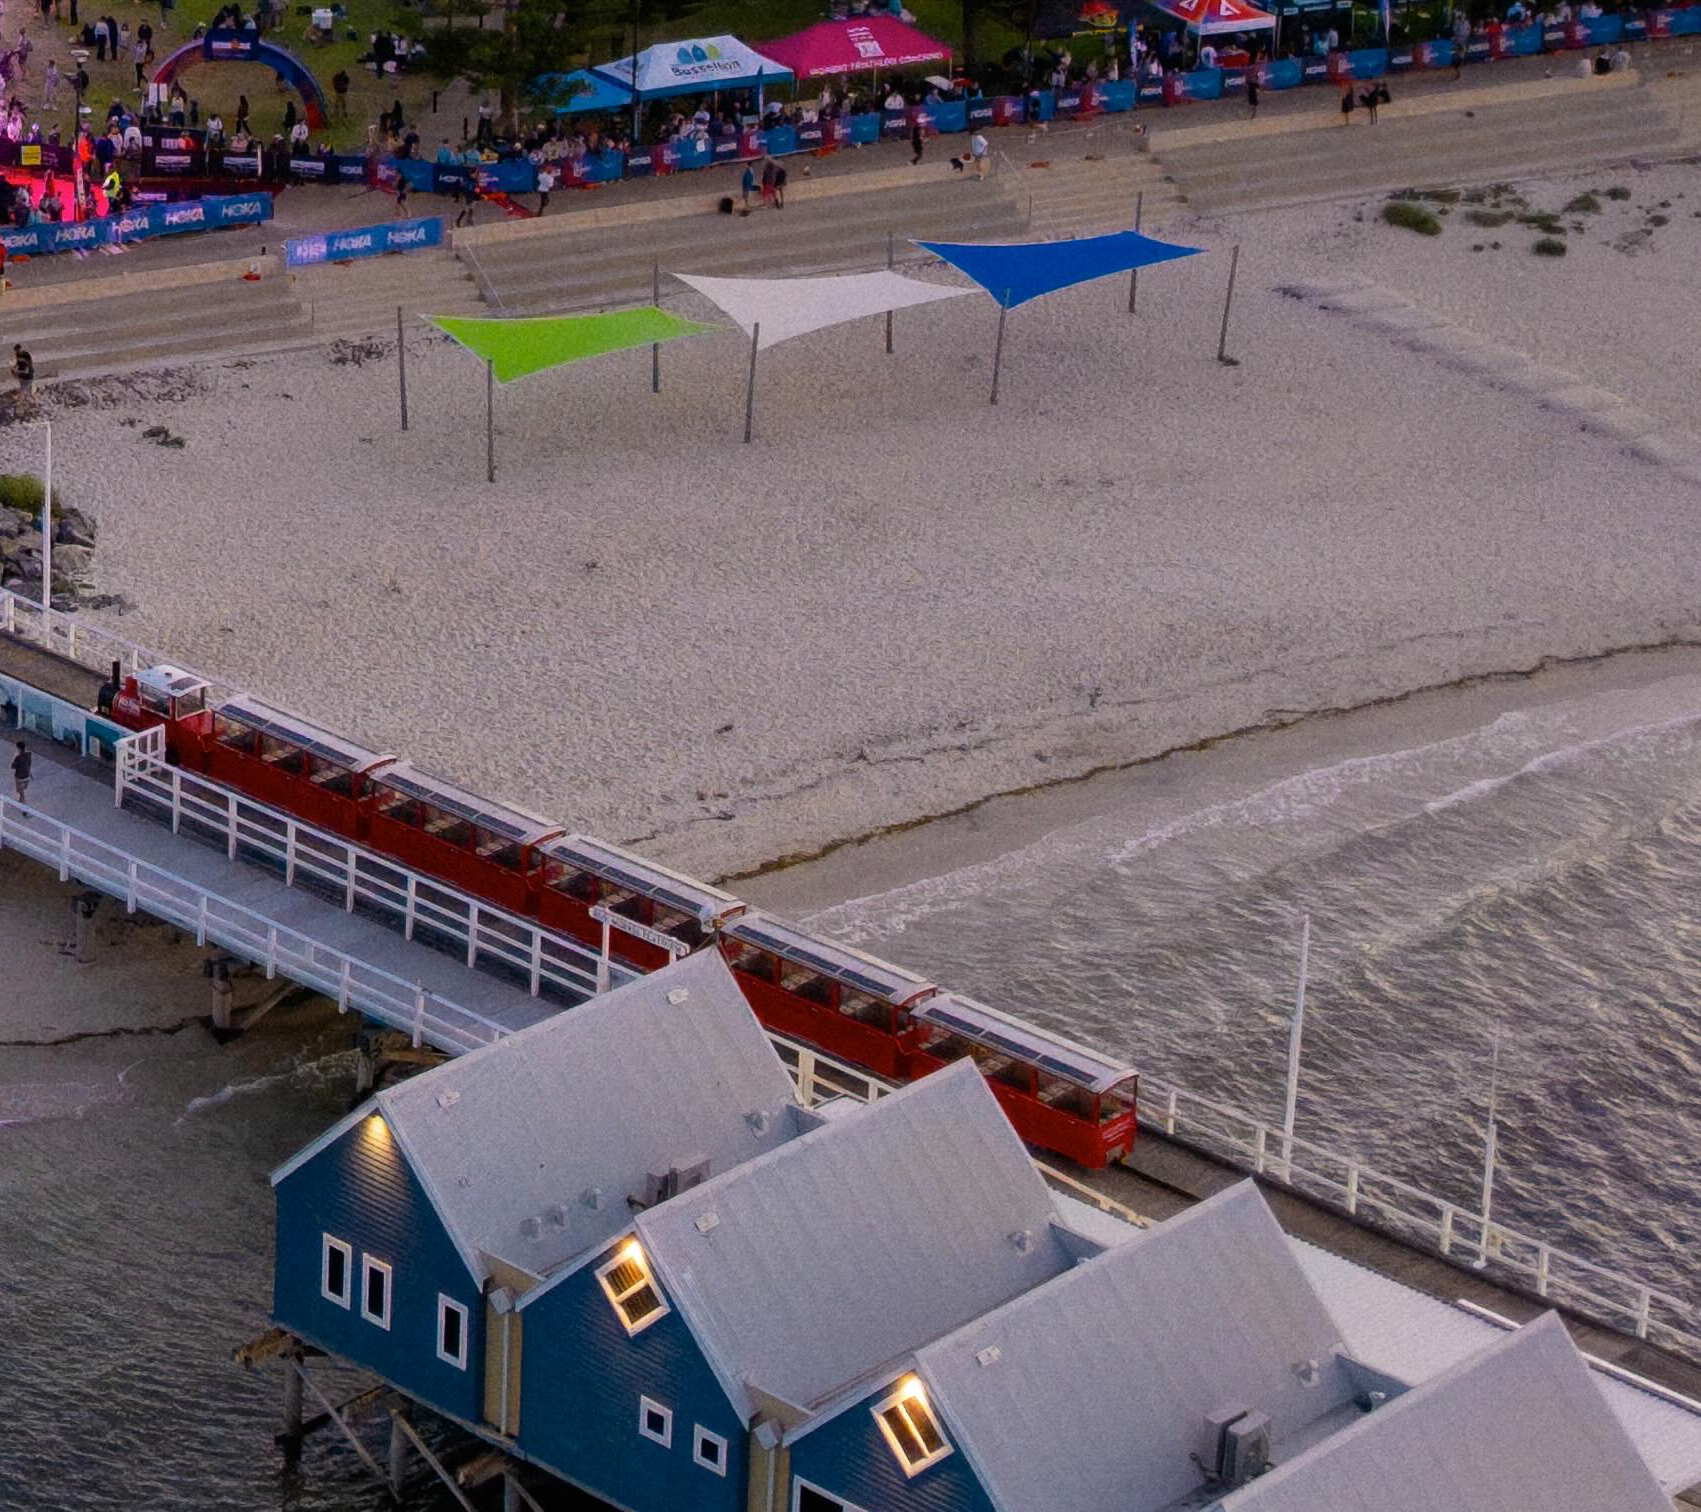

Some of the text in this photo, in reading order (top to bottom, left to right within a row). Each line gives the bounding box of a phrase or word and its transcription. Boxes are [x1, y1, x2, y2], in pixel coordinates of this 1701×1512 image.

[165, 207, 205, 226] HOKA
[221, 201, 262, 220] HOKA
[55, 225, 96, 243] HOKA
